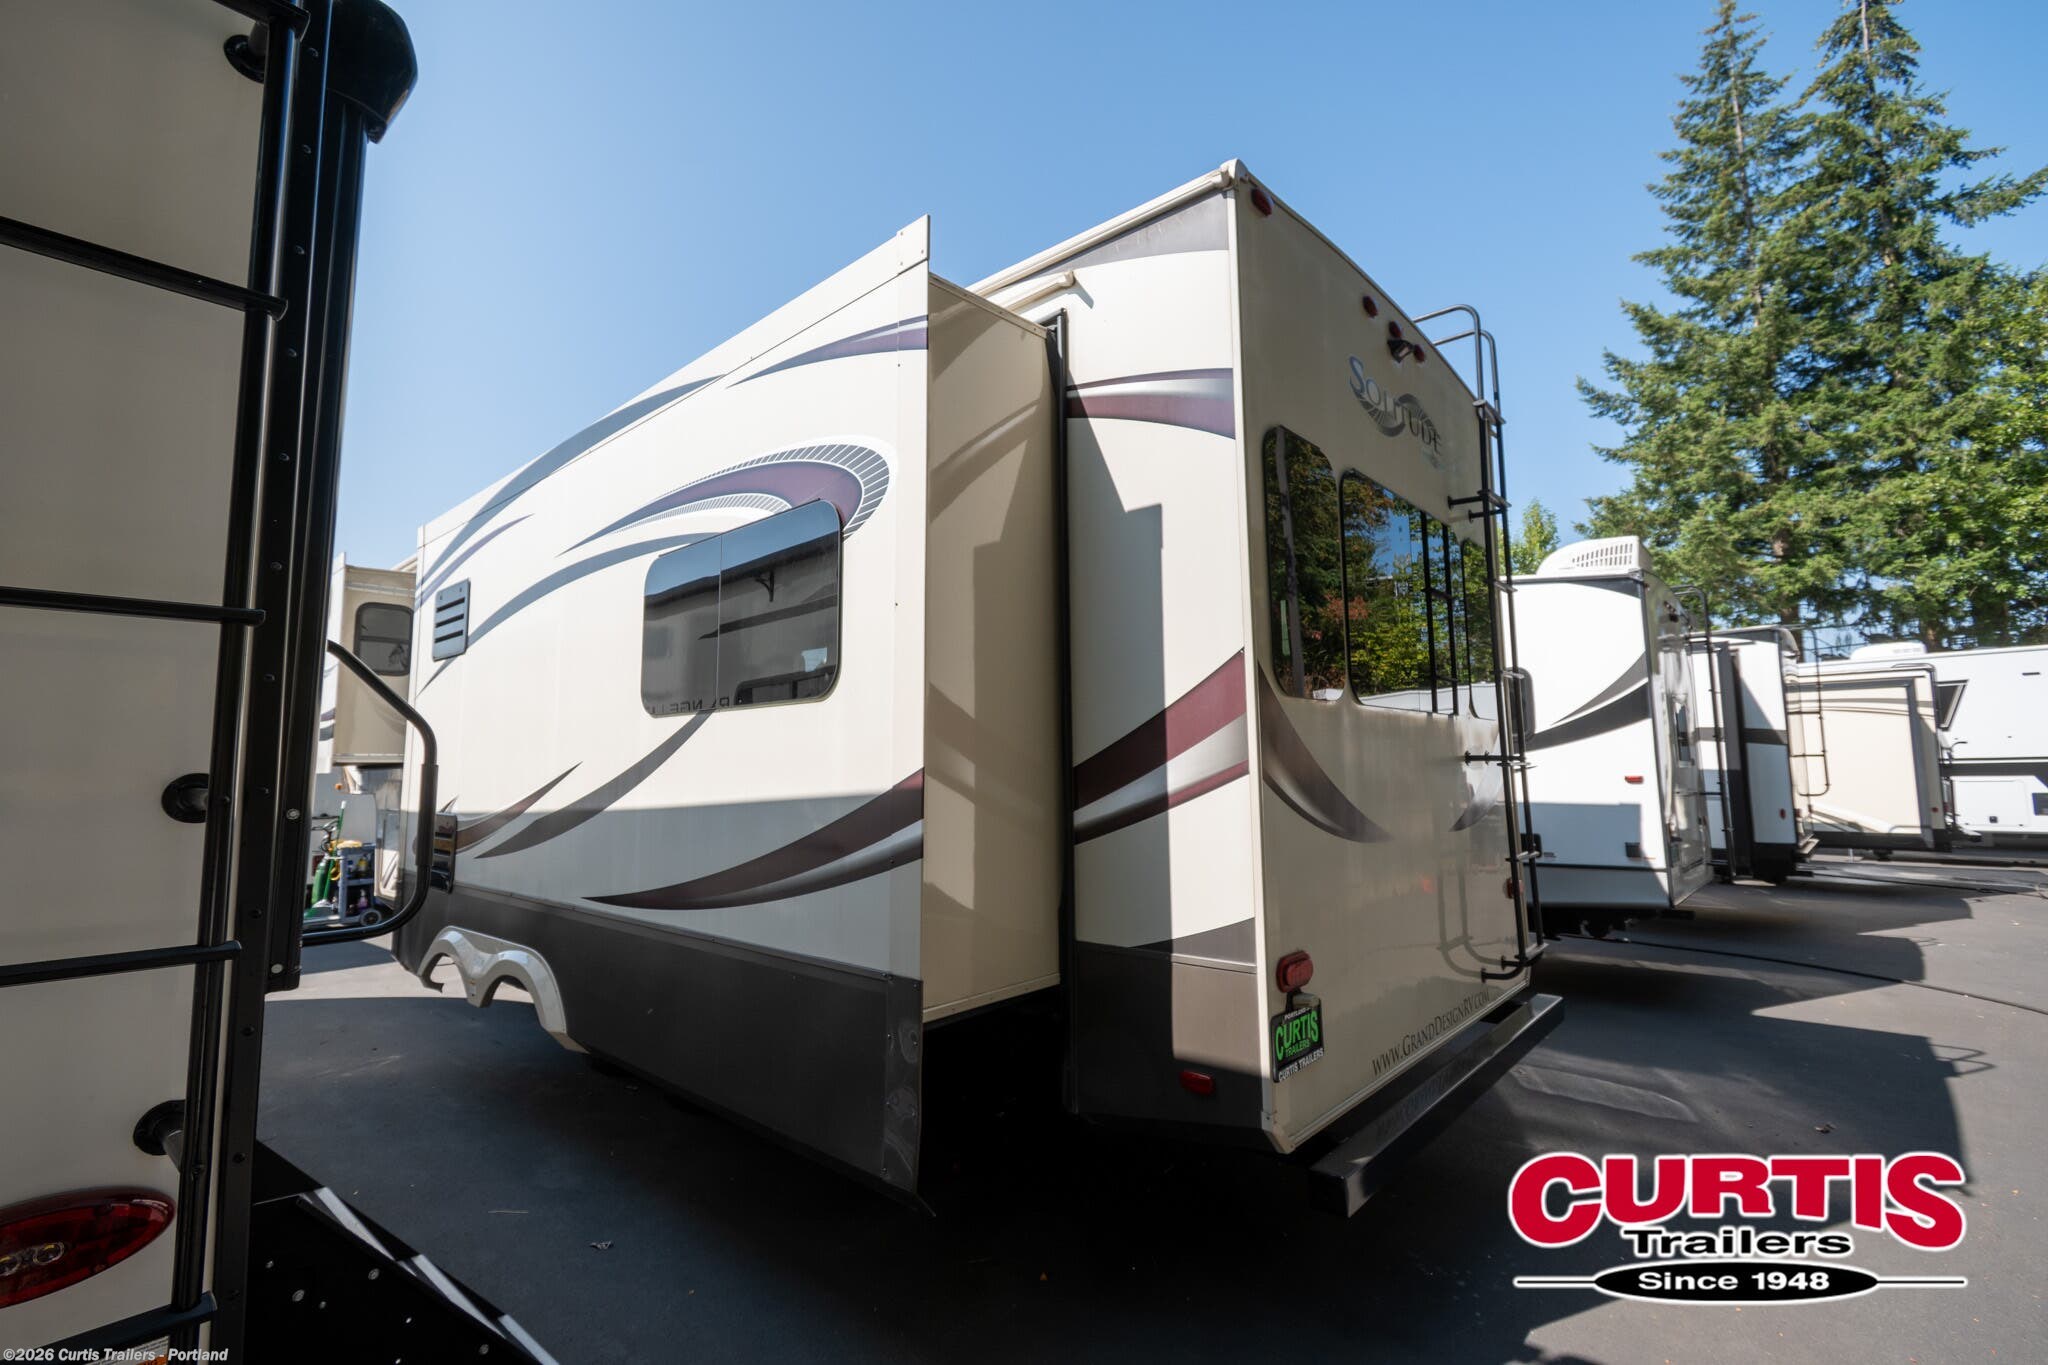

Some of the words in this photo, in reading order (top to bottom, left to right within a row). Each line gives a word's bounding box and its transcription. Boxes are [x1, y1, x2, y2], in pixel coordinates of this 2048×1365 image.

[1275, 1010, 1319, 1061] CURTIS
[1286, 1039, 1311, 1057] TRAILERS
[1279, 1061, 1299, 1081] CURTIS
[1299, 1047, 1324, 1070] TRAILERS
